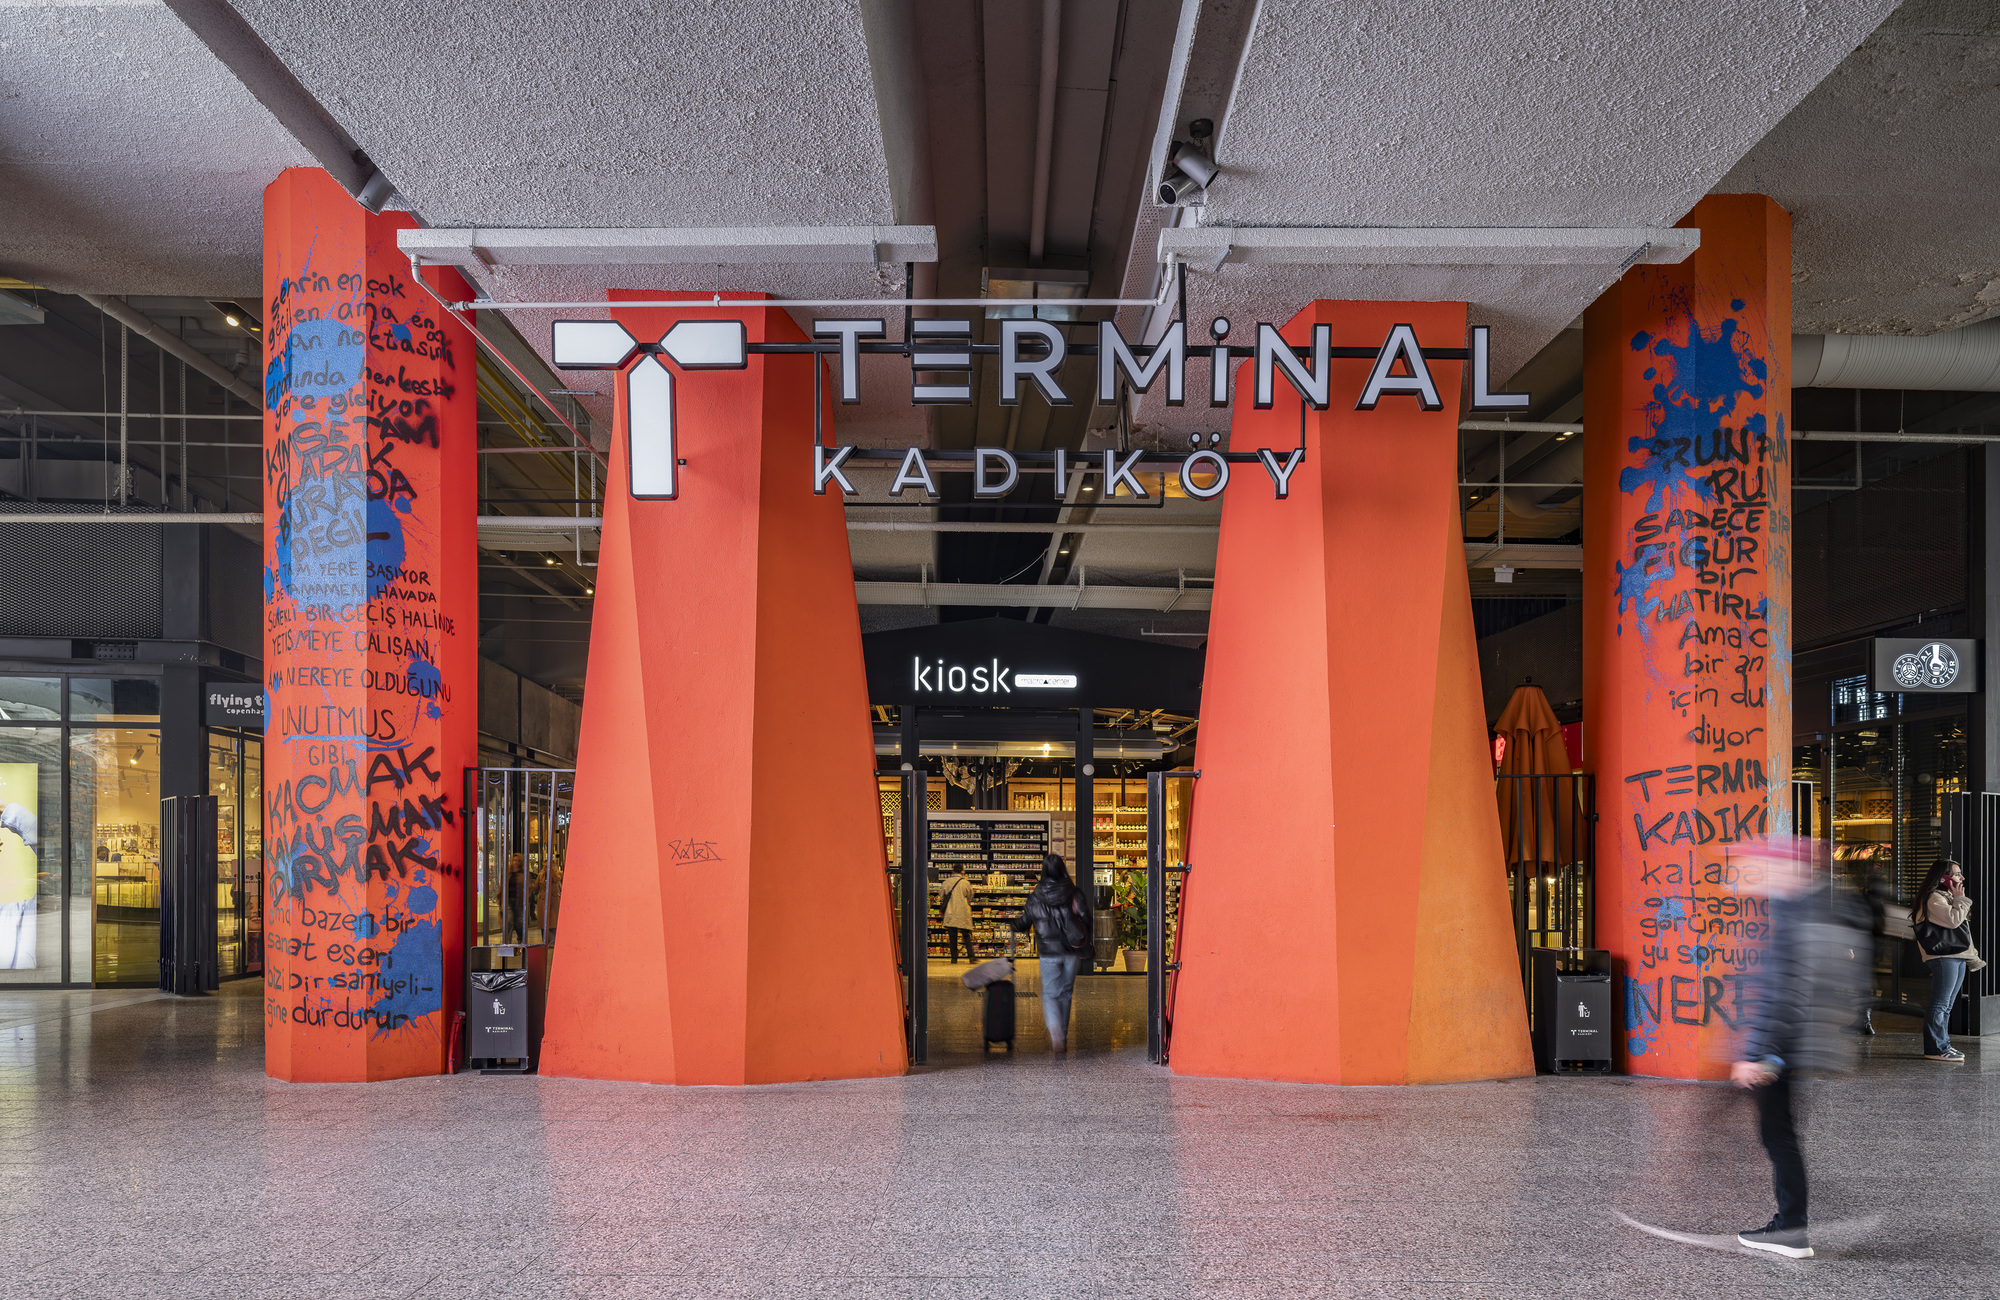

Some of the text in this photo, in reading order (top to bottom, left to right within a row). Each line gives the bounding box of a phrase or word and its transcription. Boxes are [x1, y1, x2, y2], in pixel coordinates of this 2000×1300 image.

[337, 273, 362, 292] en
[367, 274, 406, 298] çok
[411, 314, 435, 330] en
[353, 414, 440, 450] TAM
[812, 431, 1306, 500] KADIKÖY
[1634, 508, 1765, 543] SADECE
[319, 560, 359, 577] YERE
[1696, 565, 1758, 589] bir
[376, 584, 437, 603] HAVADA
[340, 601, 397, 629] GEÇİŞ
[403, 608, 456, 637] HALİNDE
[1679, 620, 1742, 651] Ama
[1684, 652, 1764, 678] bir an
[1920, 650, 1932, 662] AL
[286, 666, 355, 690] NEREYE
[360, 668, 452, 703] OLDUĞUNU
[914, 656, 1011, 693] kiosk
[209, 693, 253, 709] flying
[1669, 684, 1718, 718] için
[1690, 714, 1764, 753] diyor
[268, 900, 415, 935] ama bazen bir
[267, 932, 393, 970] sanat eseri
[289, 960, 325, 993] bir
[292, 996, 416, 1031] durdurur
